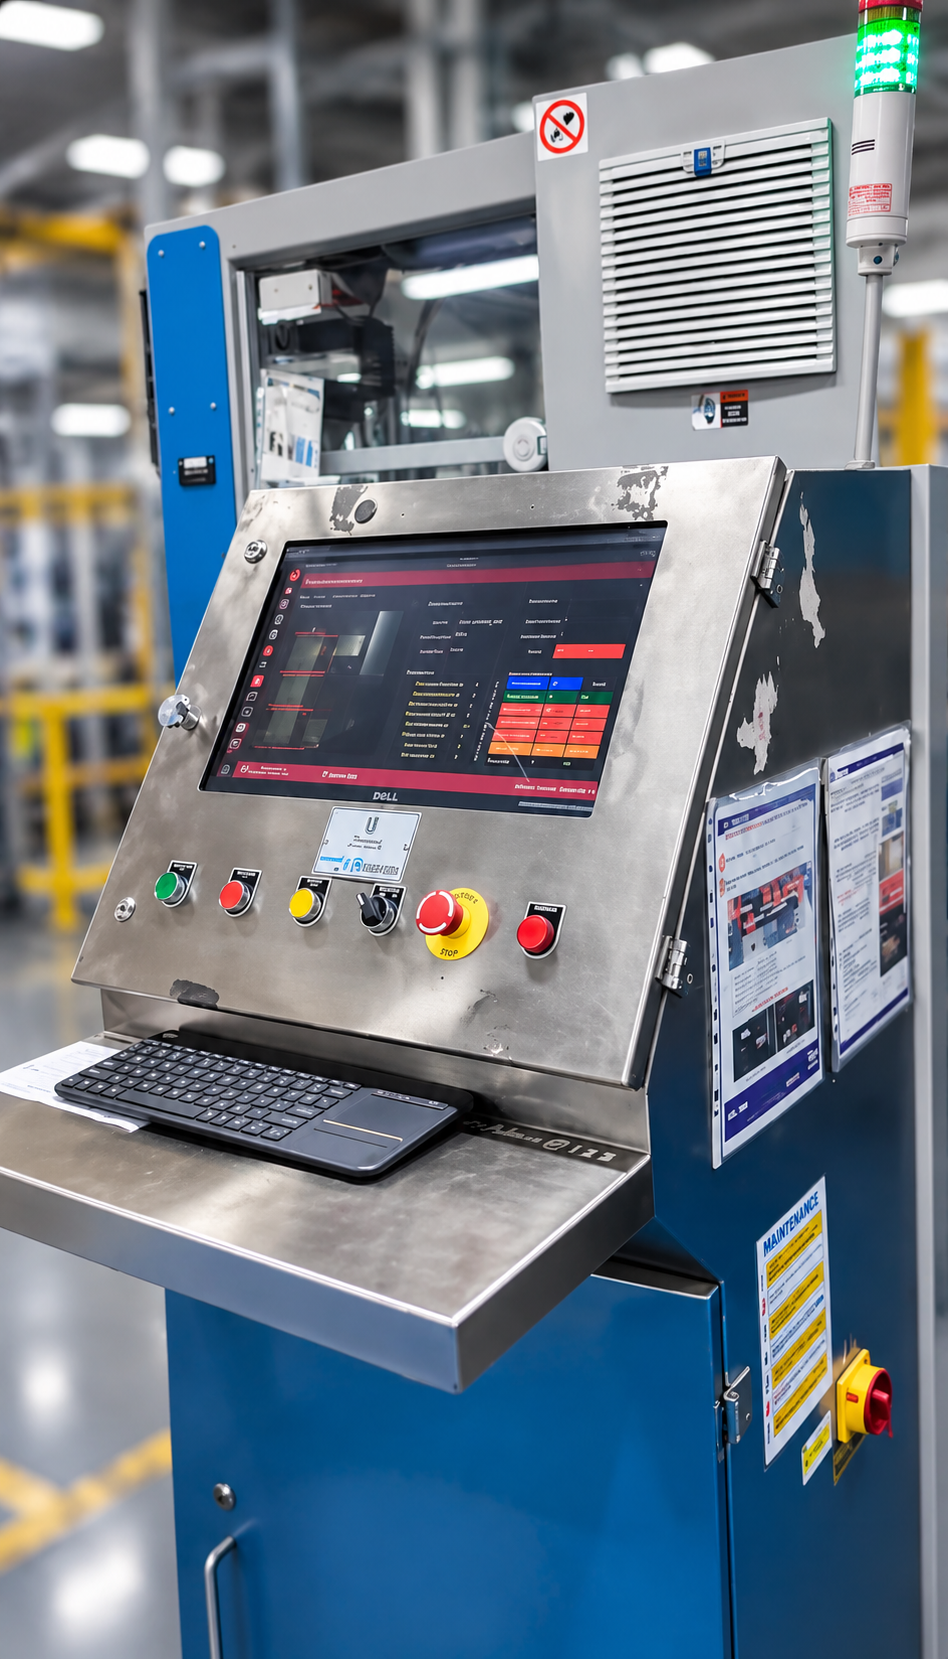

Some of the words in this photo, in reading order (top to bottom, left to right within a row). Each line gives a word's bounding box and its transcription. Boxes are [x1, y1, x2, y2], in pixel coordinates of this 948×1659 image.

[373, 791, 398, 802] DELL
[440, 948, 458, 957] STOP
[763, 1191, 819, 1257] MAINTENANCE
